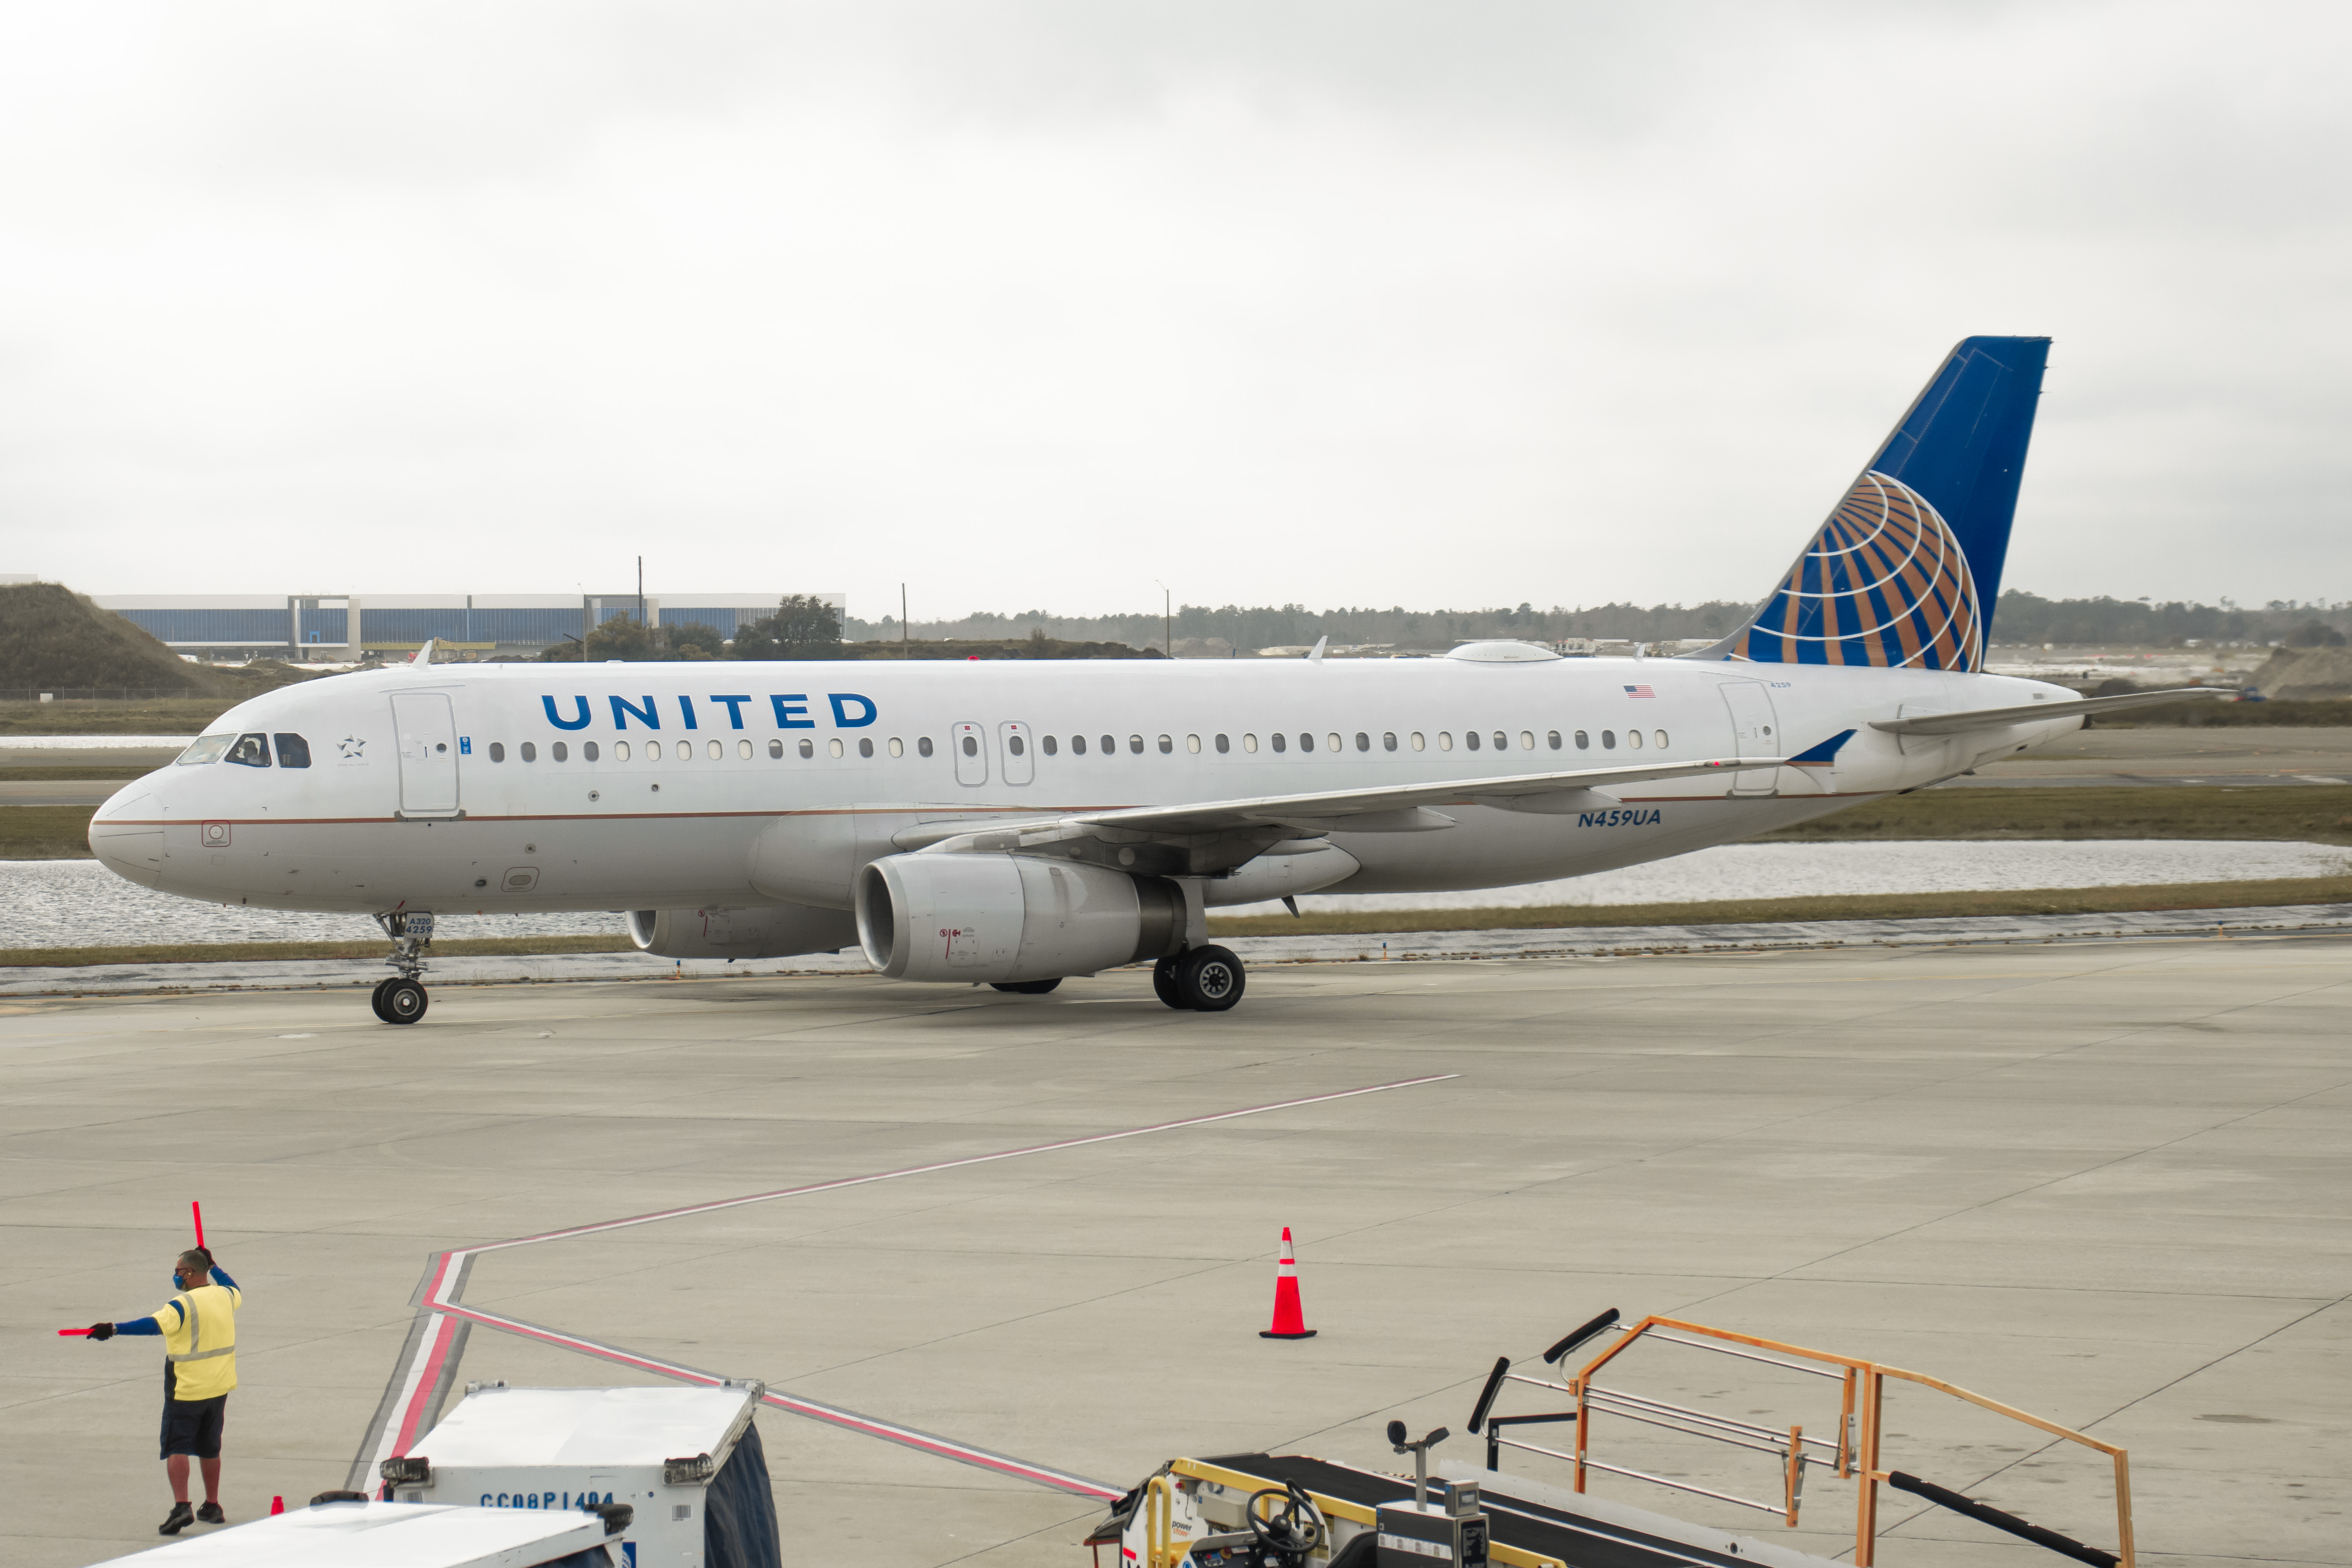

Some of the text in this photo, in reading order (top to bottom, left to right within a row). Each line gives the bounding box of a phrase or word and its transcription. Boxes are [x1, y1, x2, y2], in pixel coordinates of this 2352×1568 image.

[541, 693, 878, 731] UNITED
[1578, 809, 1661, 827] N459UA
[1172, 1521, 1192, 1531] power
[1173, 1528, 1188, 1537] stow
